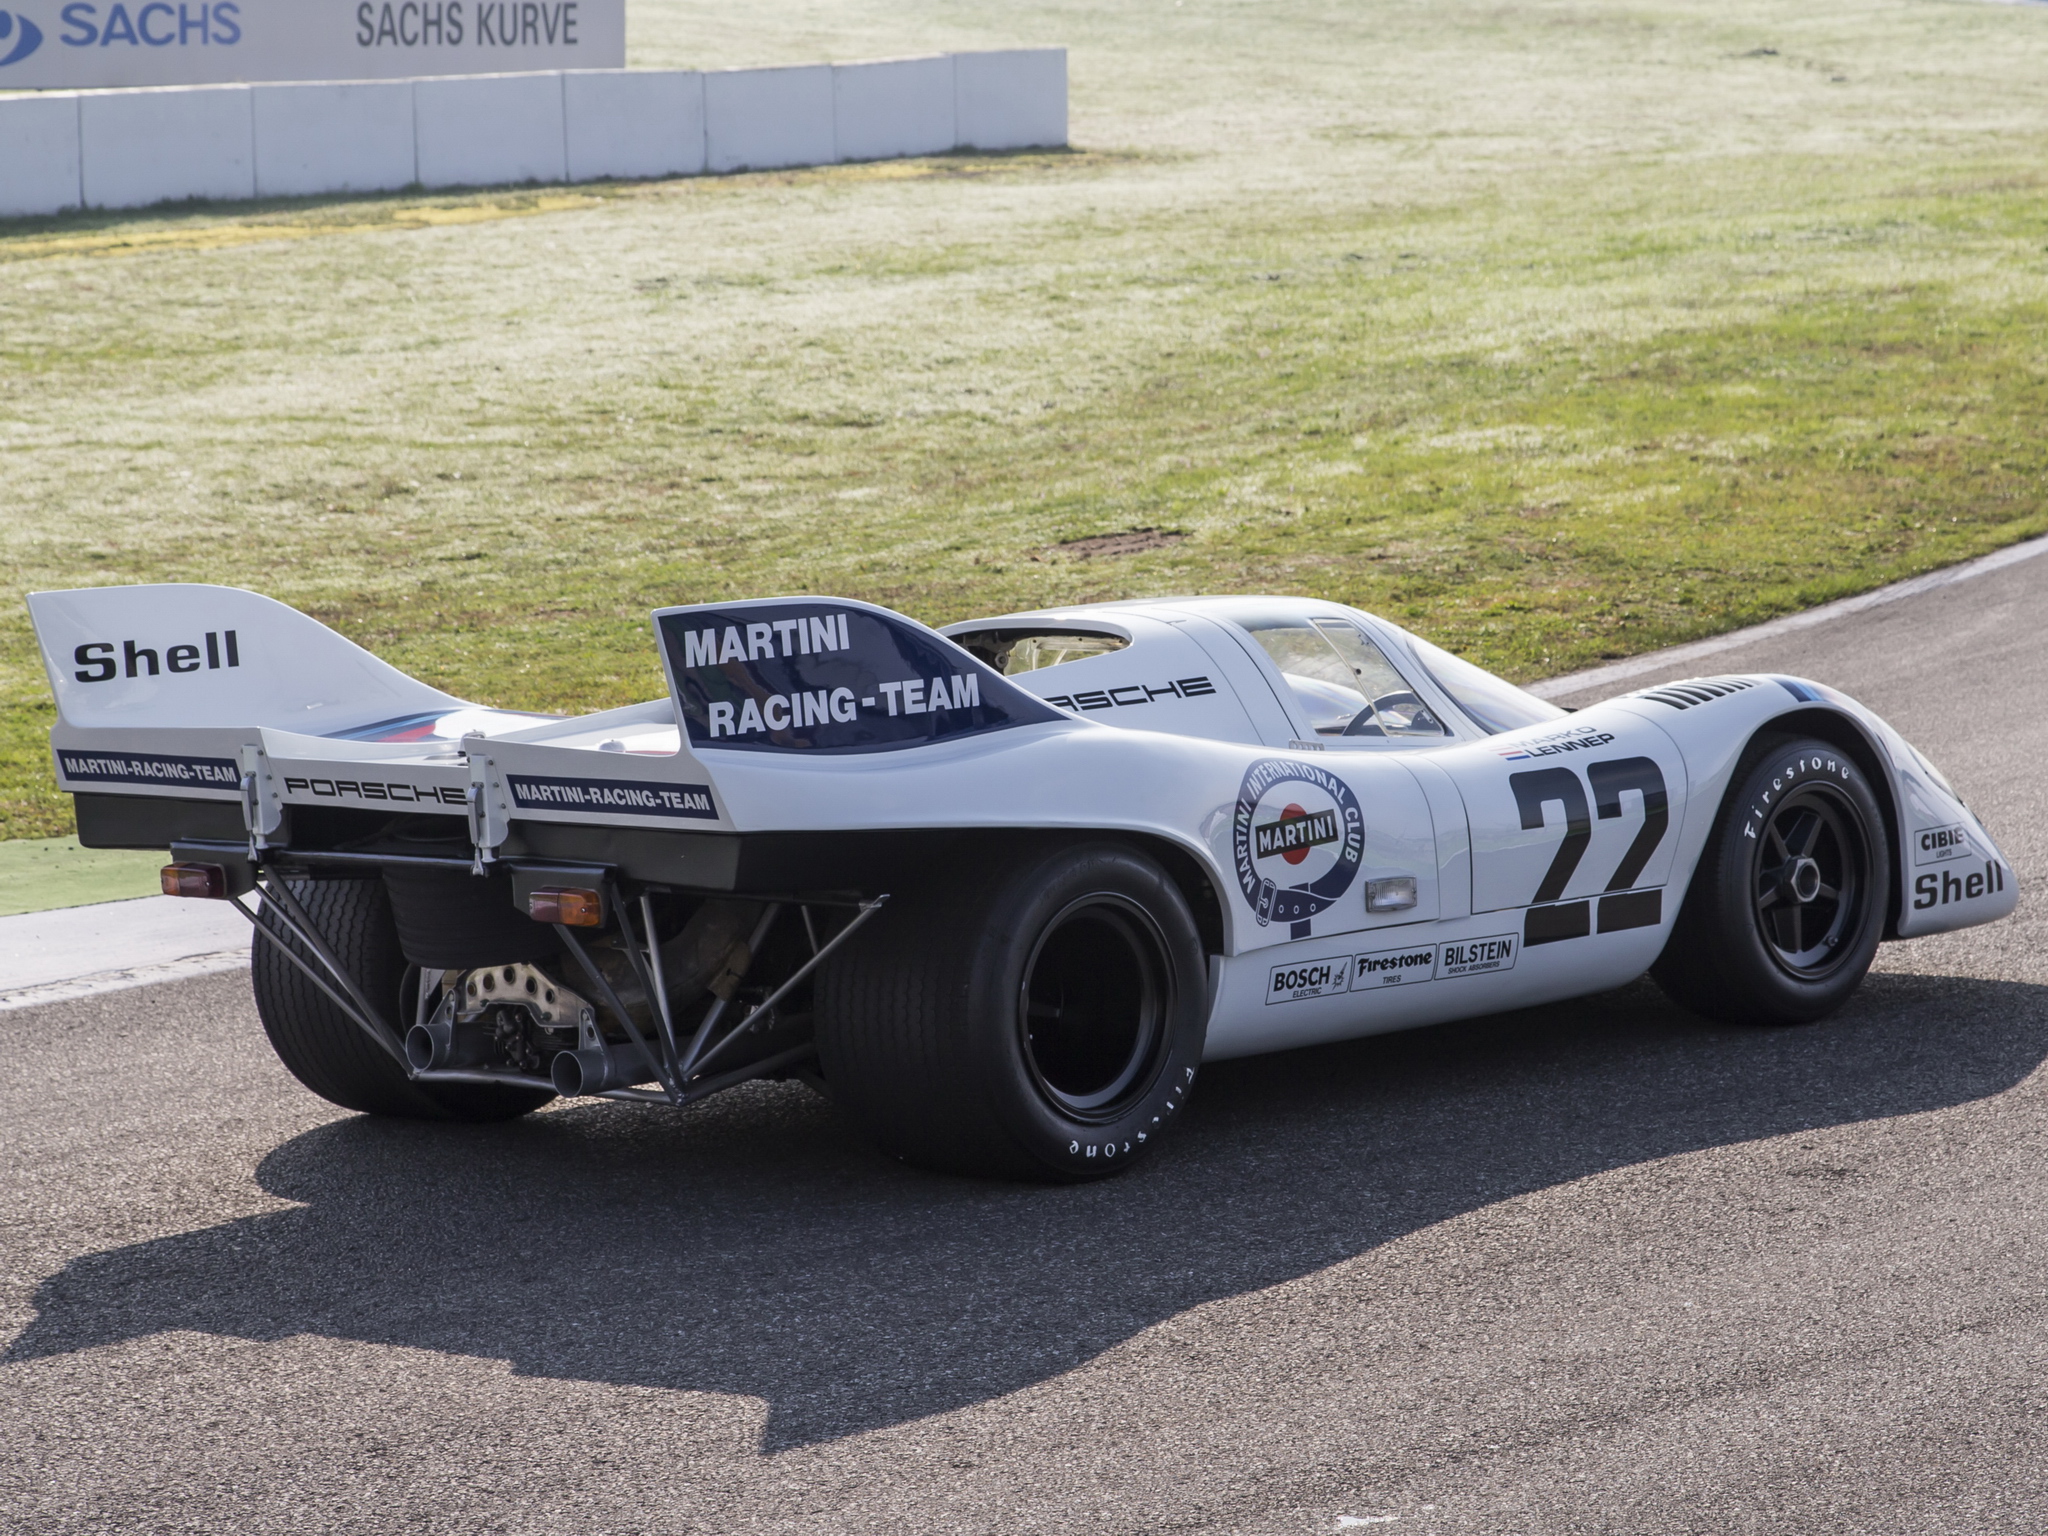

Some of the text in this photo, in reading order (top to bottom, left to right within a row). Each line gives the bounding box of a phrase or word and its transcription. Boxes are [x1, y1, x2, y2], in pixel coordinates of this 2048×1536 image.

[60, 2, 242, 47] SACHS
[356, 1, 579, 48] SACHS KURVE
[74, 630, 240, 683] Shell
[684, 614, 850, 669] MARTINI
[708, 673, 980, 738] RACING-TEAM
[1044, 676, 1217, 712] RSCHE
[1524, 733, 1615, 757] LENNEP
[64, 757, 238, 783] MARTINI-RACING-TEAM
[284, 777, 468, 805] PORSCHE
[514, 783, 710, 811] MARTINI-RACING-TEAM
[1745, 757, 1850, 838] Firestone
[1236, 760, 1361, 895] MARTINI INTERNATIONAL CLUB
[1259, 815, 1334, 853] MARTINI
[1921, 827, 1964, 851] CIBIE
[1509, 756, 1669, 948] 22
[1914, 860, 2003, 910] Shell
[1357, 952, 1433, 977] Firestone
[1444, 940, 1512, 966] BILSTEIN
[1448, 961, 1500, 975] SHOCK ABSORBERS
[1273, 965, 1331, 992] BOSCH
[1292, 987, 1322, 998] ELECTRIC
[1382, 975, 1401, 985] TIRES
